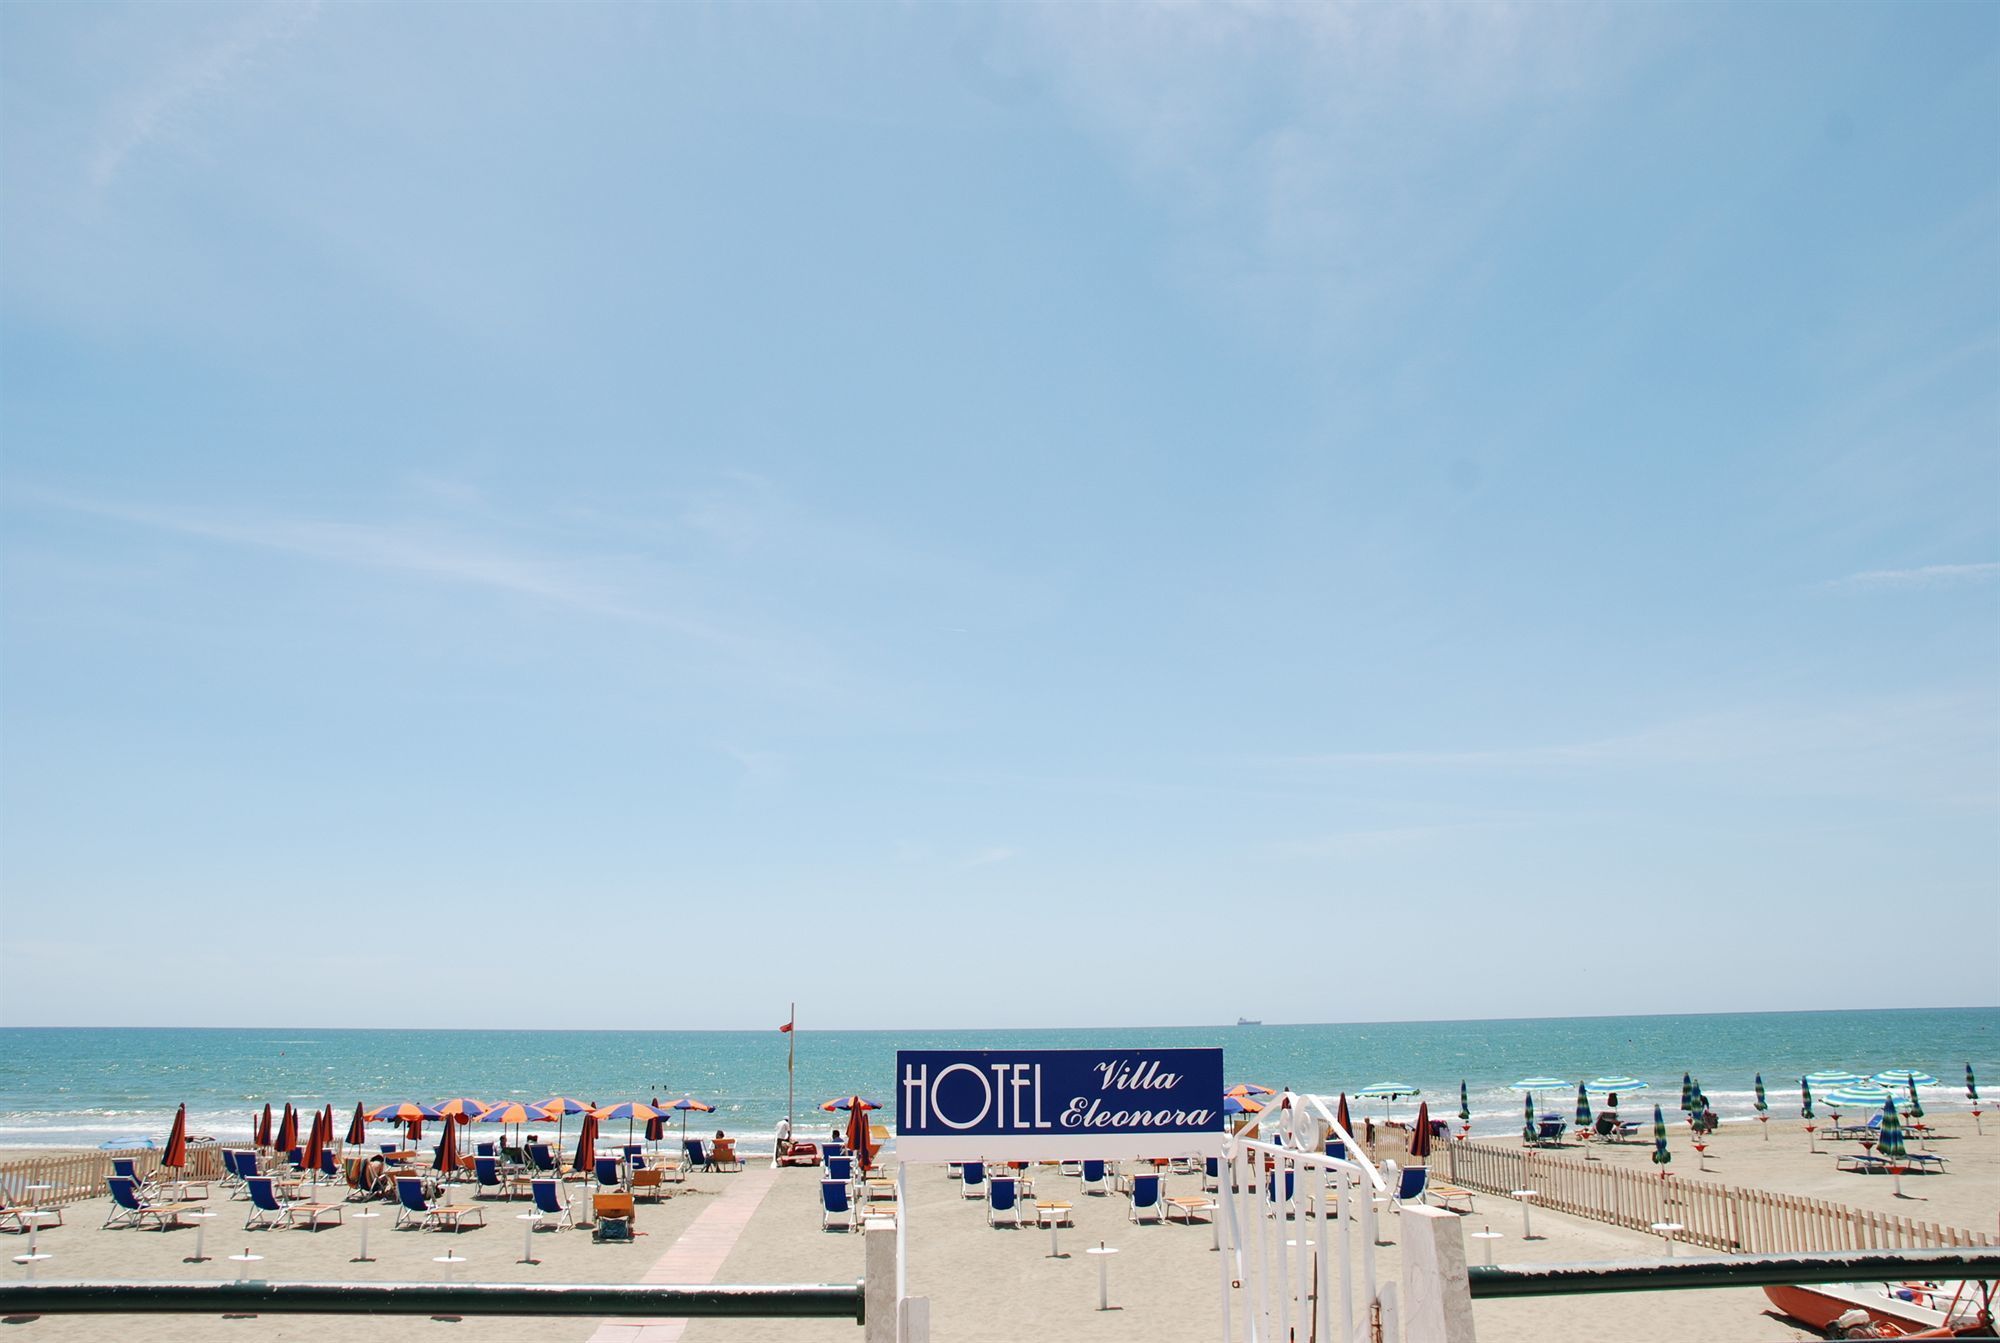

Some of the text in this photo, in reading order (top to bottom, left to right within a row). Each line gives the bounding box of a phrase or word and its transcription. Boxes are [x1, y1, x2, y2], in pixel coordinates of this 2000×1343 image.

[1093, 1059, 1183, 1090] Villa
[903, 1063, 1052, 1129] HOTEL
[1059, 1096, 1216, 1128] Eleonora
